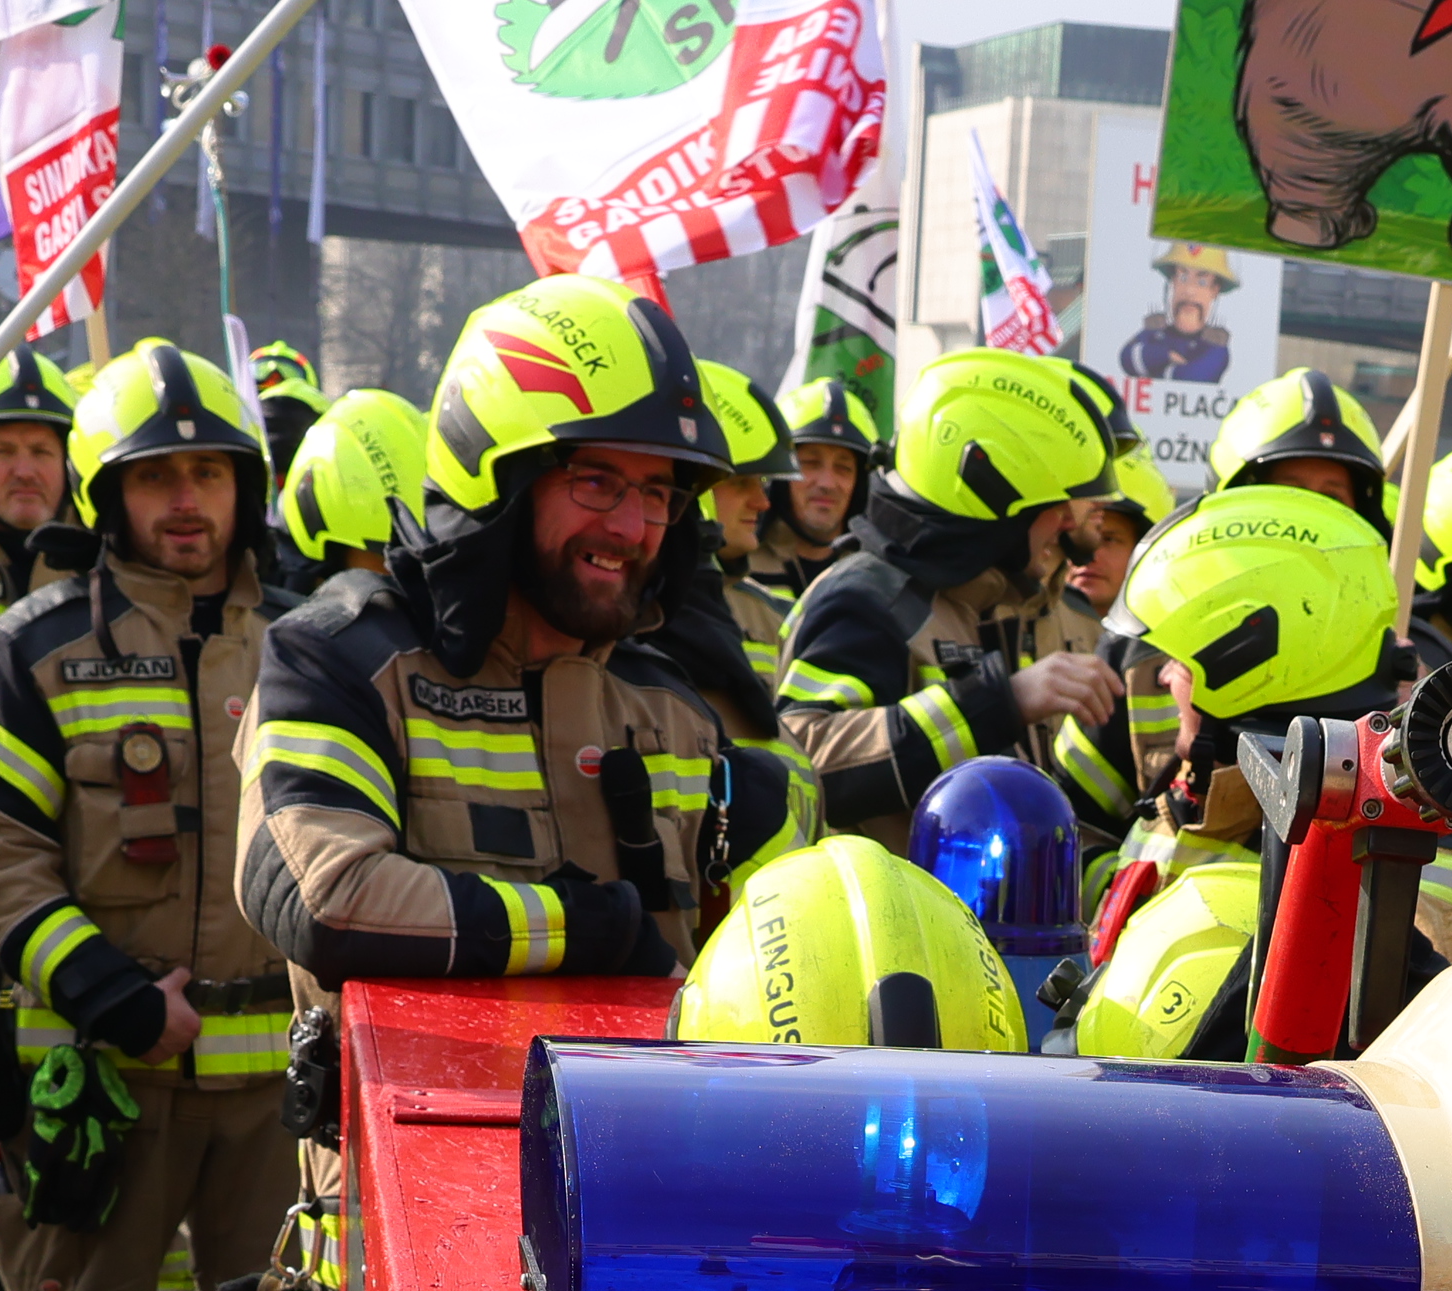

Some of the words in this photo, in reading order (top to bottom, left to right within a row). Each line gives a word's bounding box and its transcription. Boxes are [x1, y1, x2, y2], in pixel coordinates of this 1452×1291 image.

[992, 376, 1088, 448] GRADIŠAR
[1188, 518, 1321, 549] JELOVČAN
[1161, 991, 1183, 1016] 3
